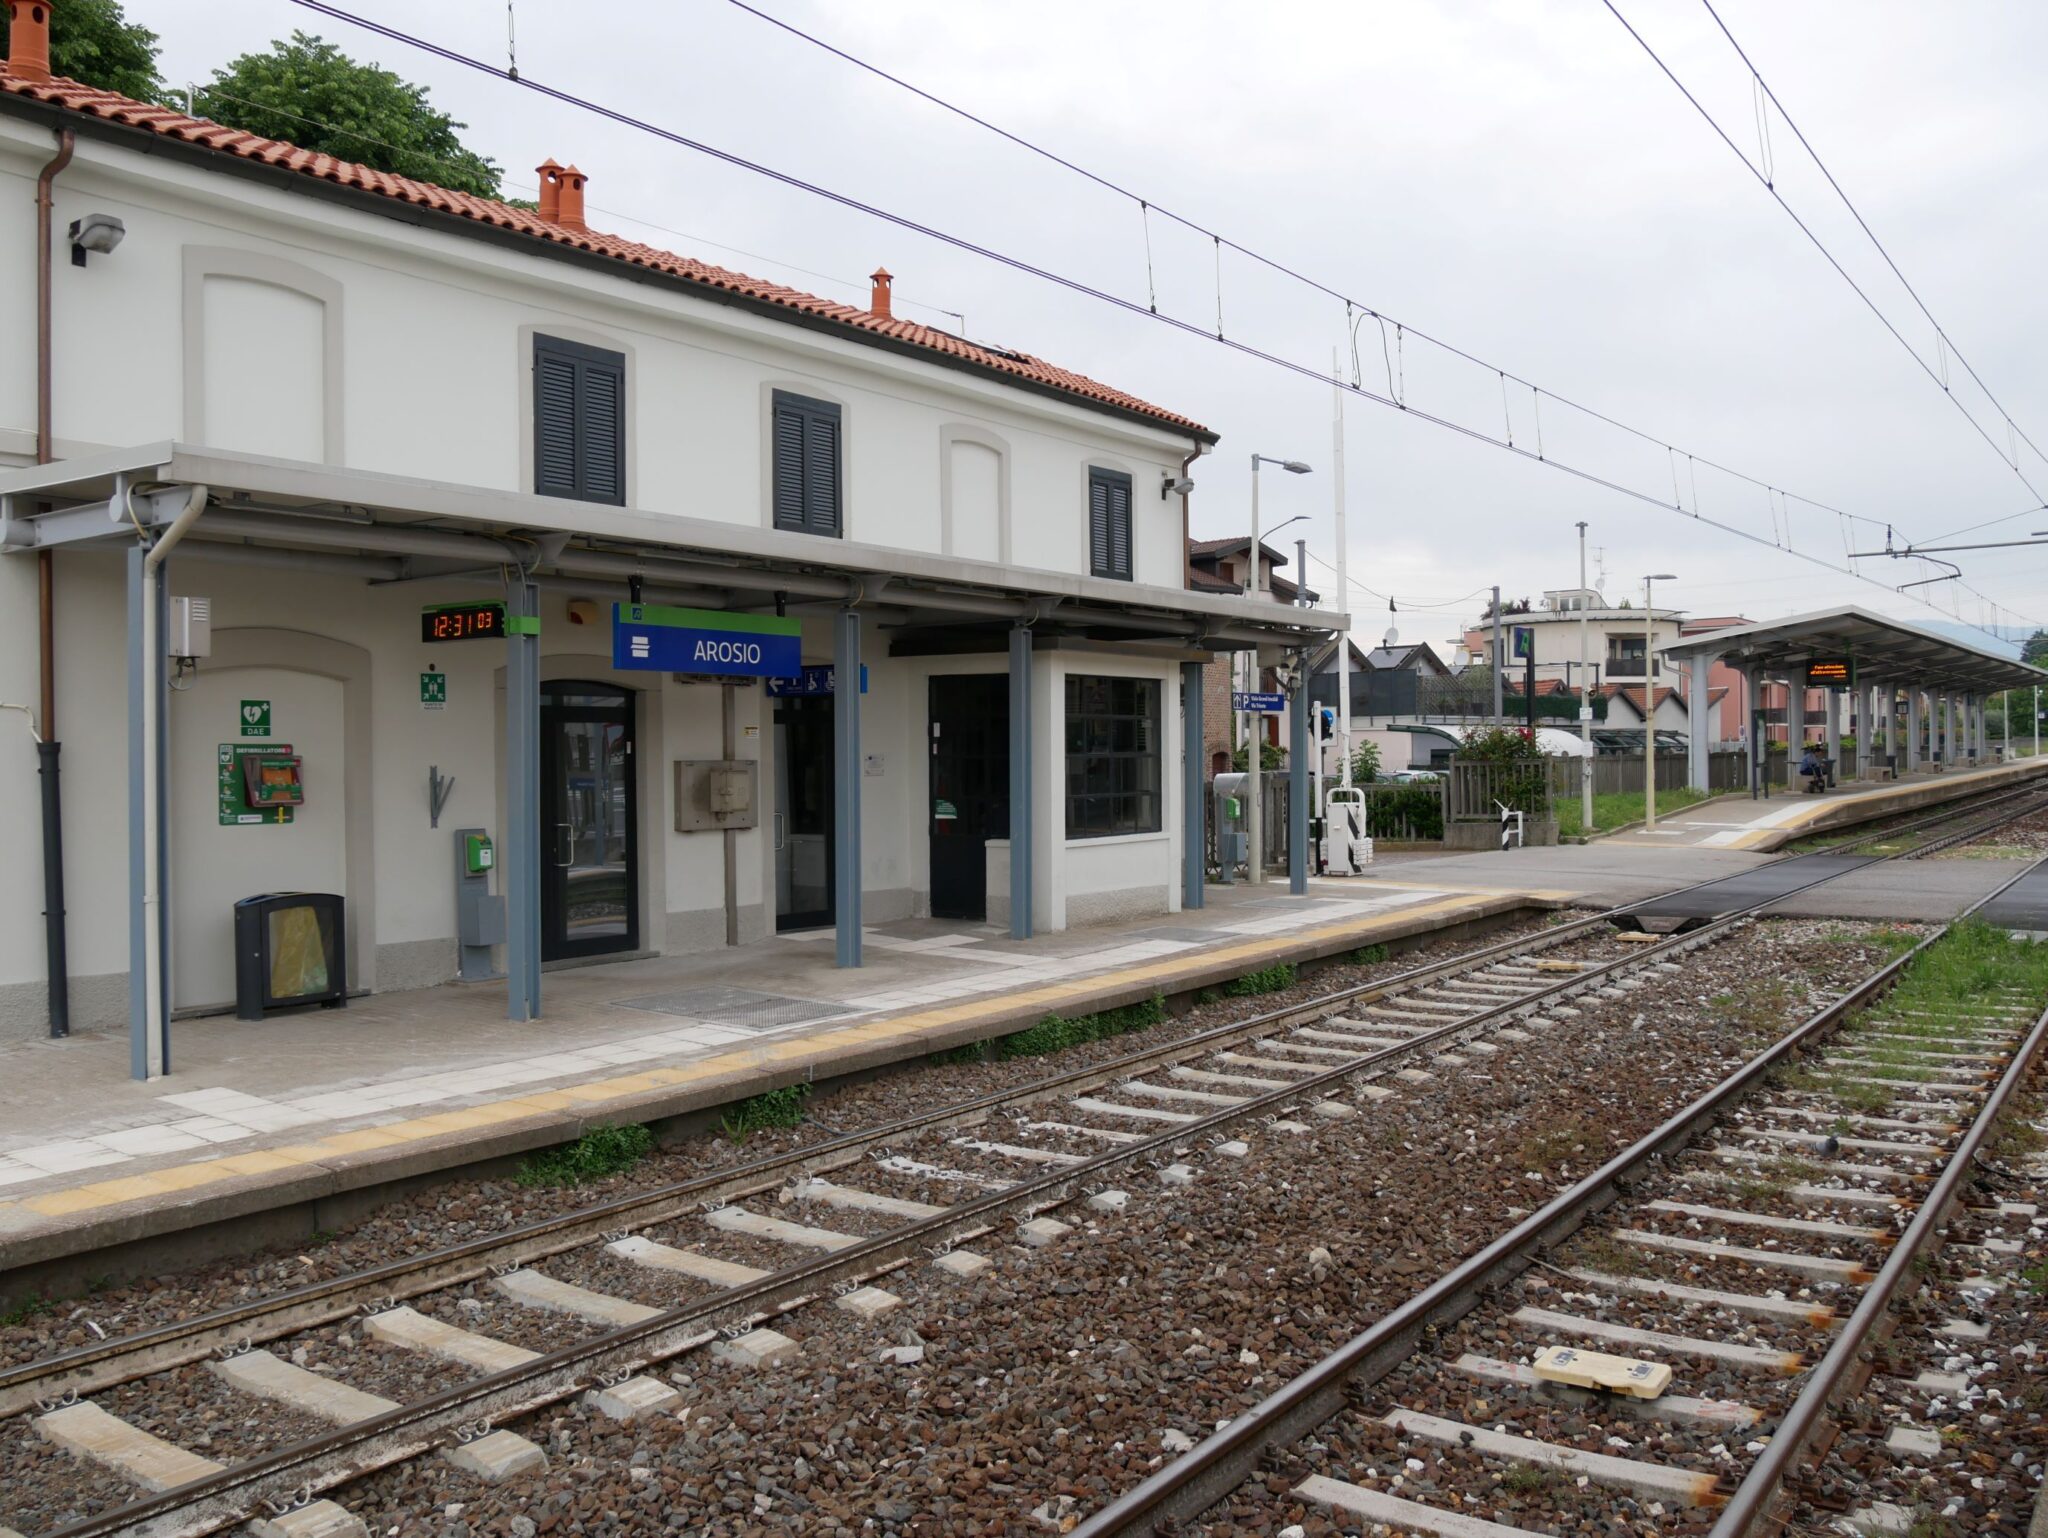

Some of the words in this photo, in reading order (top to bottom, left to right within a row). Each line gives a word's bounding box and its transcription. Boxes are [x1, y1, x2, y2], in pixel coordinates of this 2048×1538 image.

[433, 614, 472, 637] 12:31
[477, 612, 492, 629] 03
[693, 640, 761, 664] AROSIO
[1243, 695, 1249, 708] P
